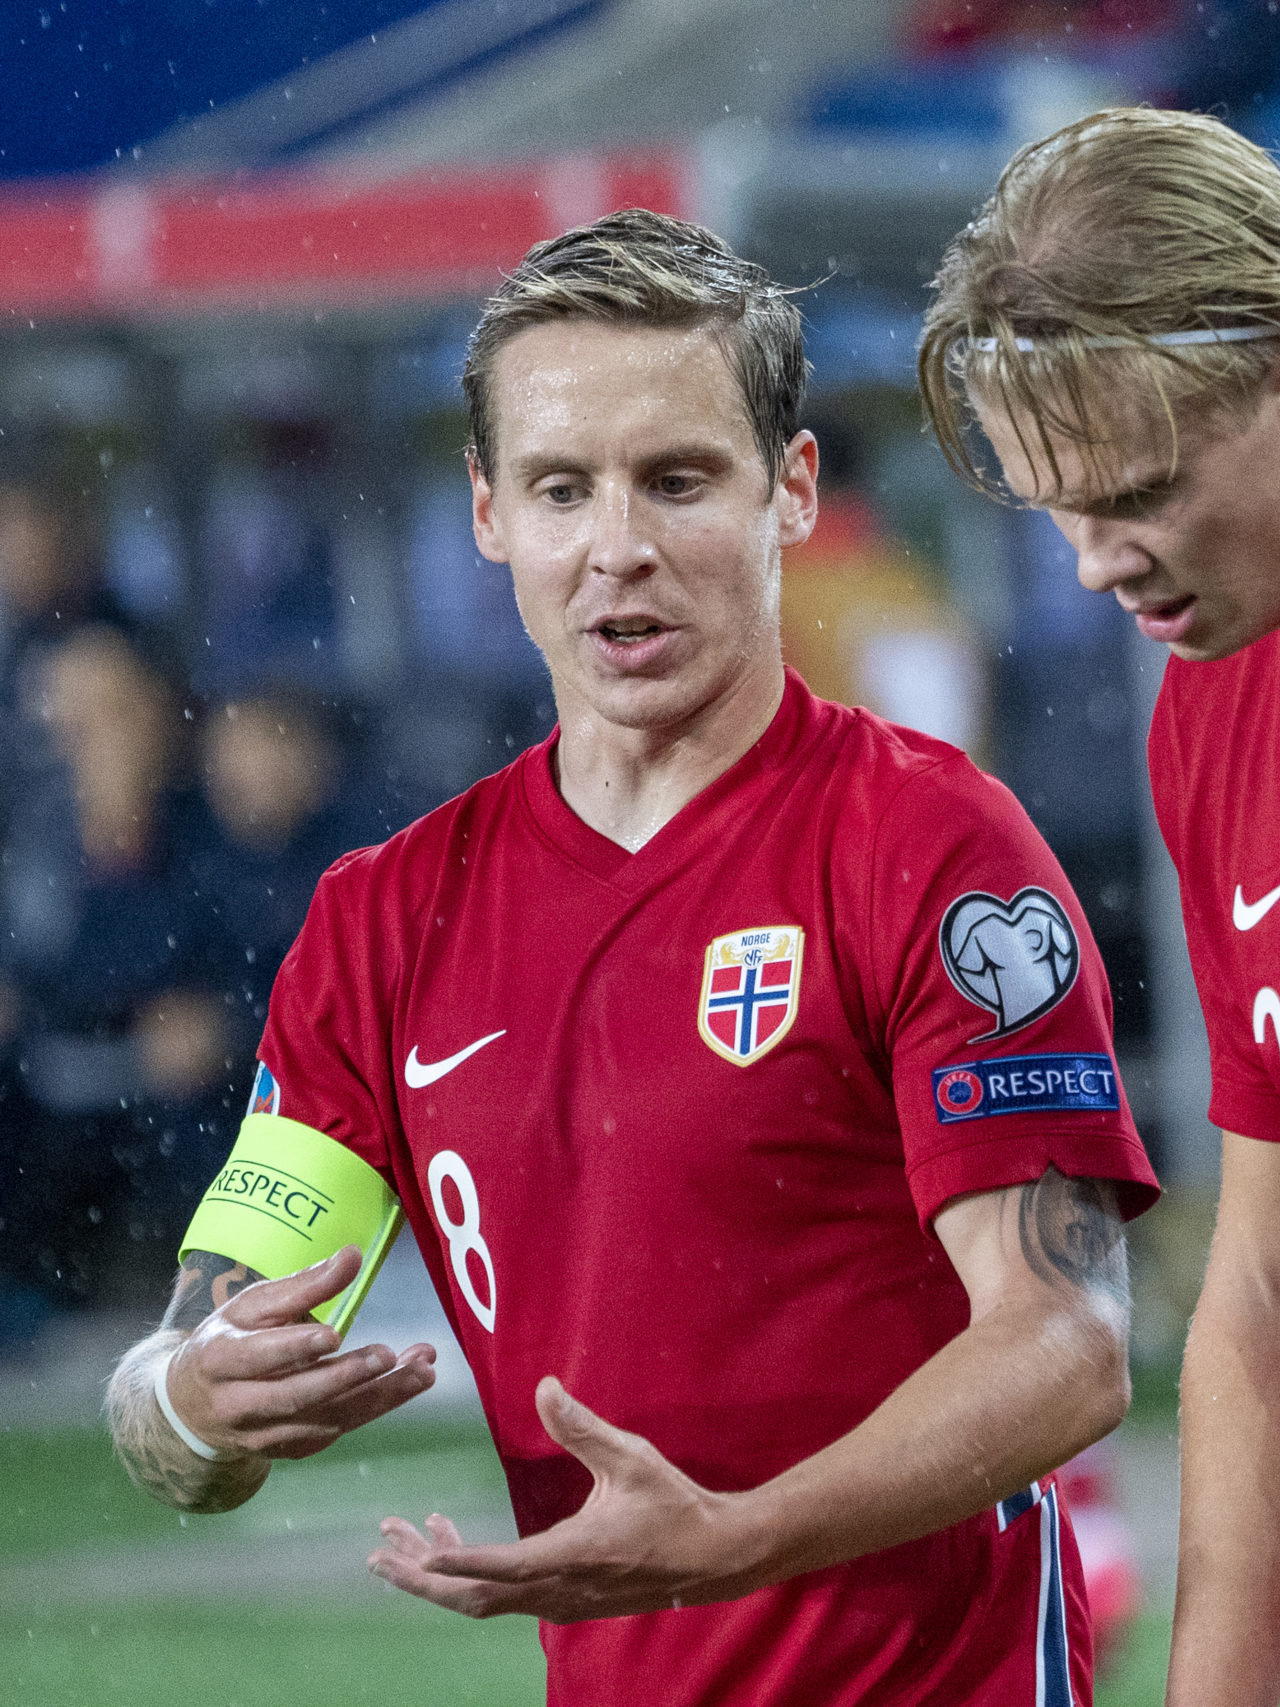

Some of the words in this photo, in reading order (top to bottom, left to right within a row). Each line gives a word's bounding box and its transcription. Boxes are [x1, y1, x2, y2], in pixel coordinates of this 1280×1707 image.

[741, 930, 772, 946] NORGE
[988, 1069, 1113, 1099] RESPECT
[211, 1168, 329, 1228] RESPECT
[427, 1150, 497, 1335] 8
